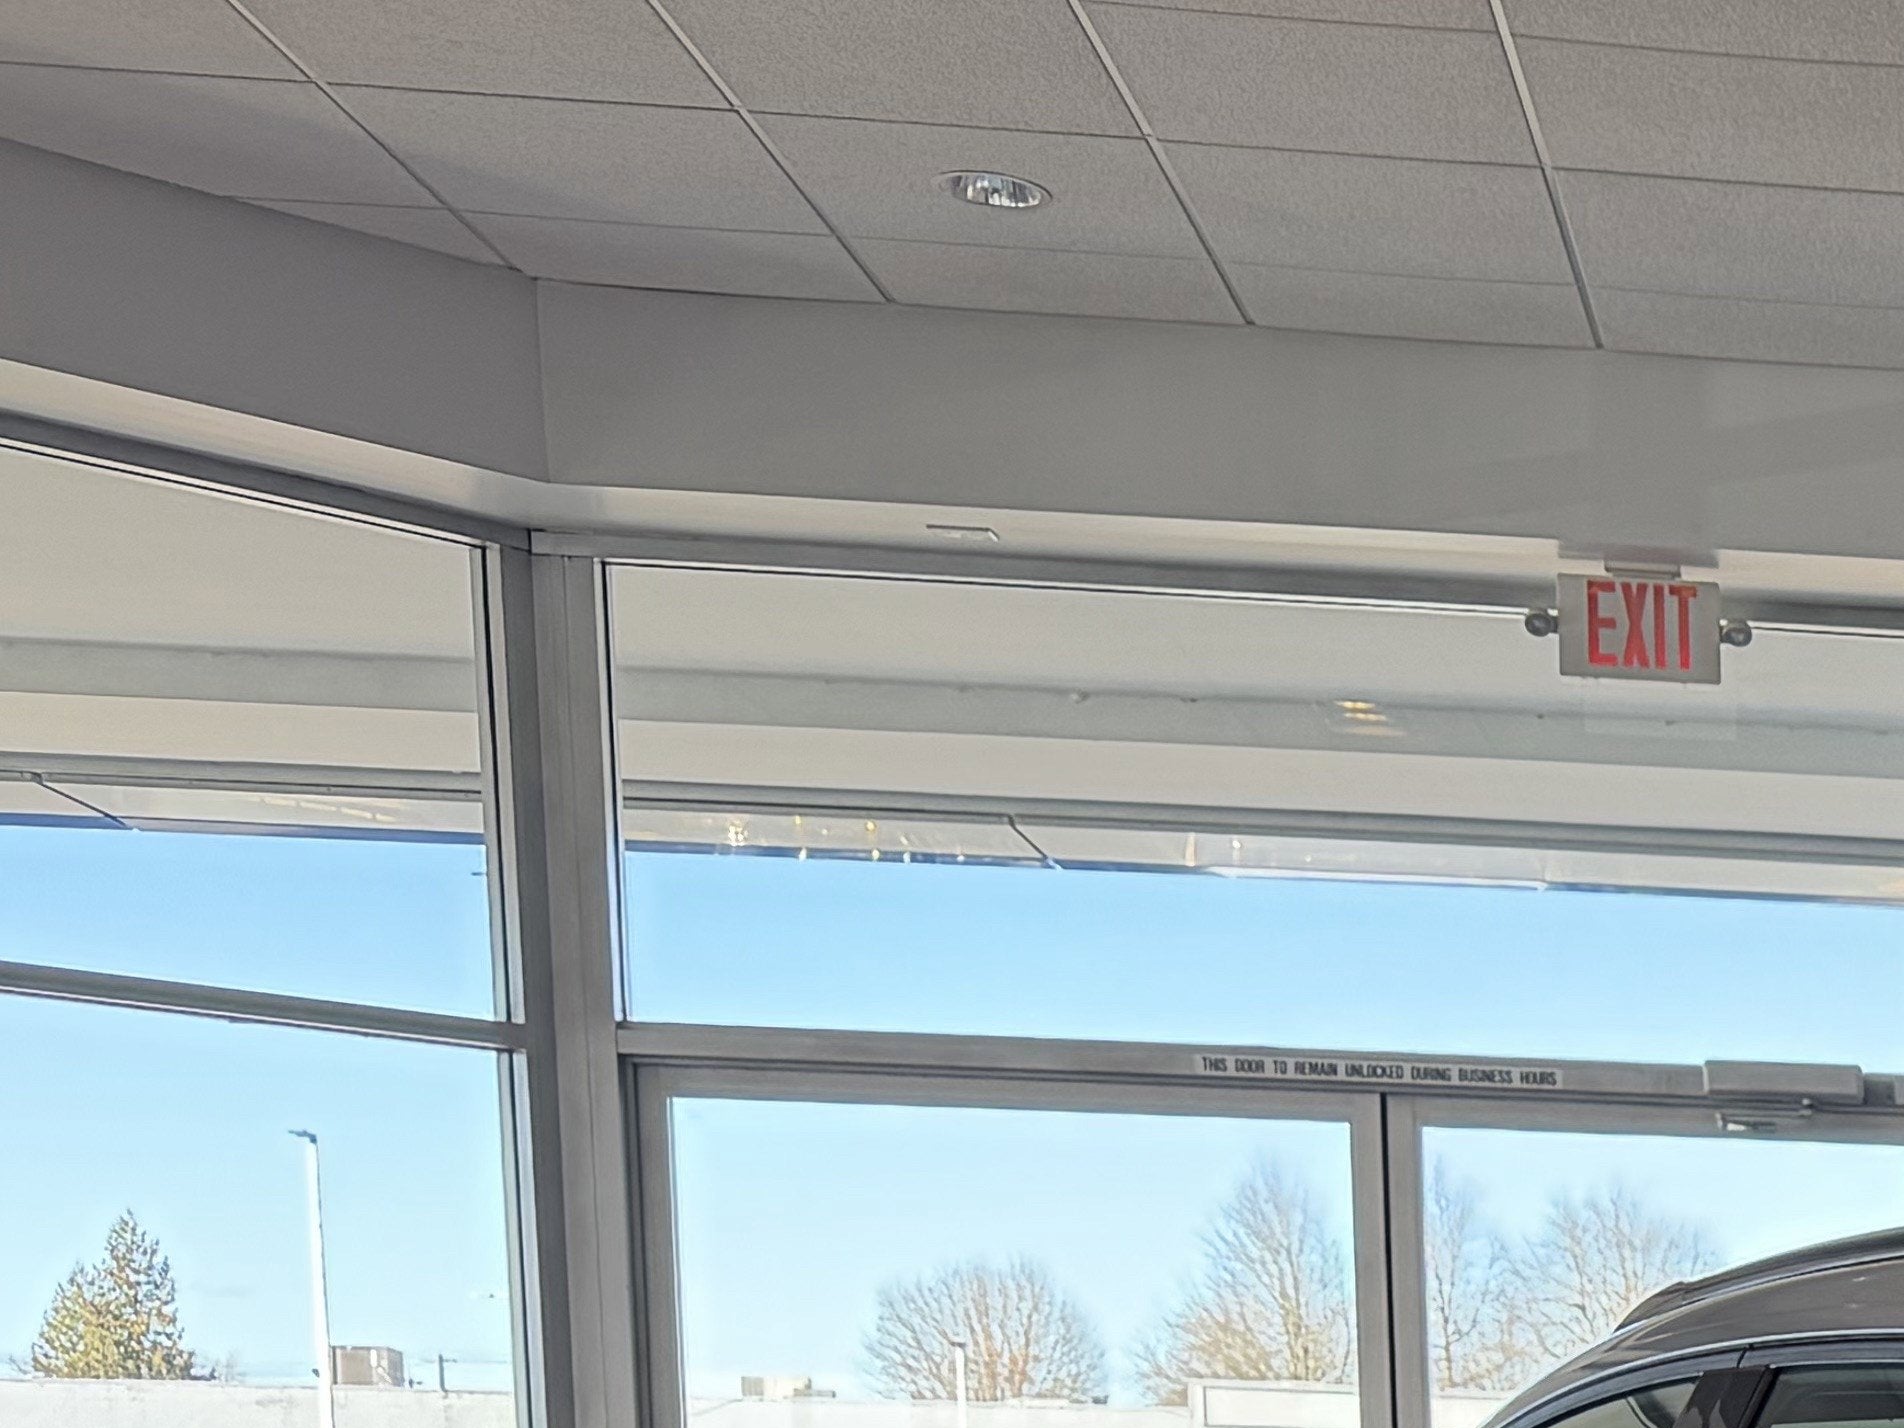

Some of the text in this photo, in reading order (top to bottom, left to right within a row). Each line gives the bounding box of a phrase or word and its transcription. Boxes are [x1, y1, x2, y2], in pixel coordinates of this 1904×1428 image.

[1586, 579, 1699, 672] EXIT
[1202, 1056, 1558, 1087] THIS DOOR TO REMAIN UNLOCKED DURING BUSINESS HOURS
